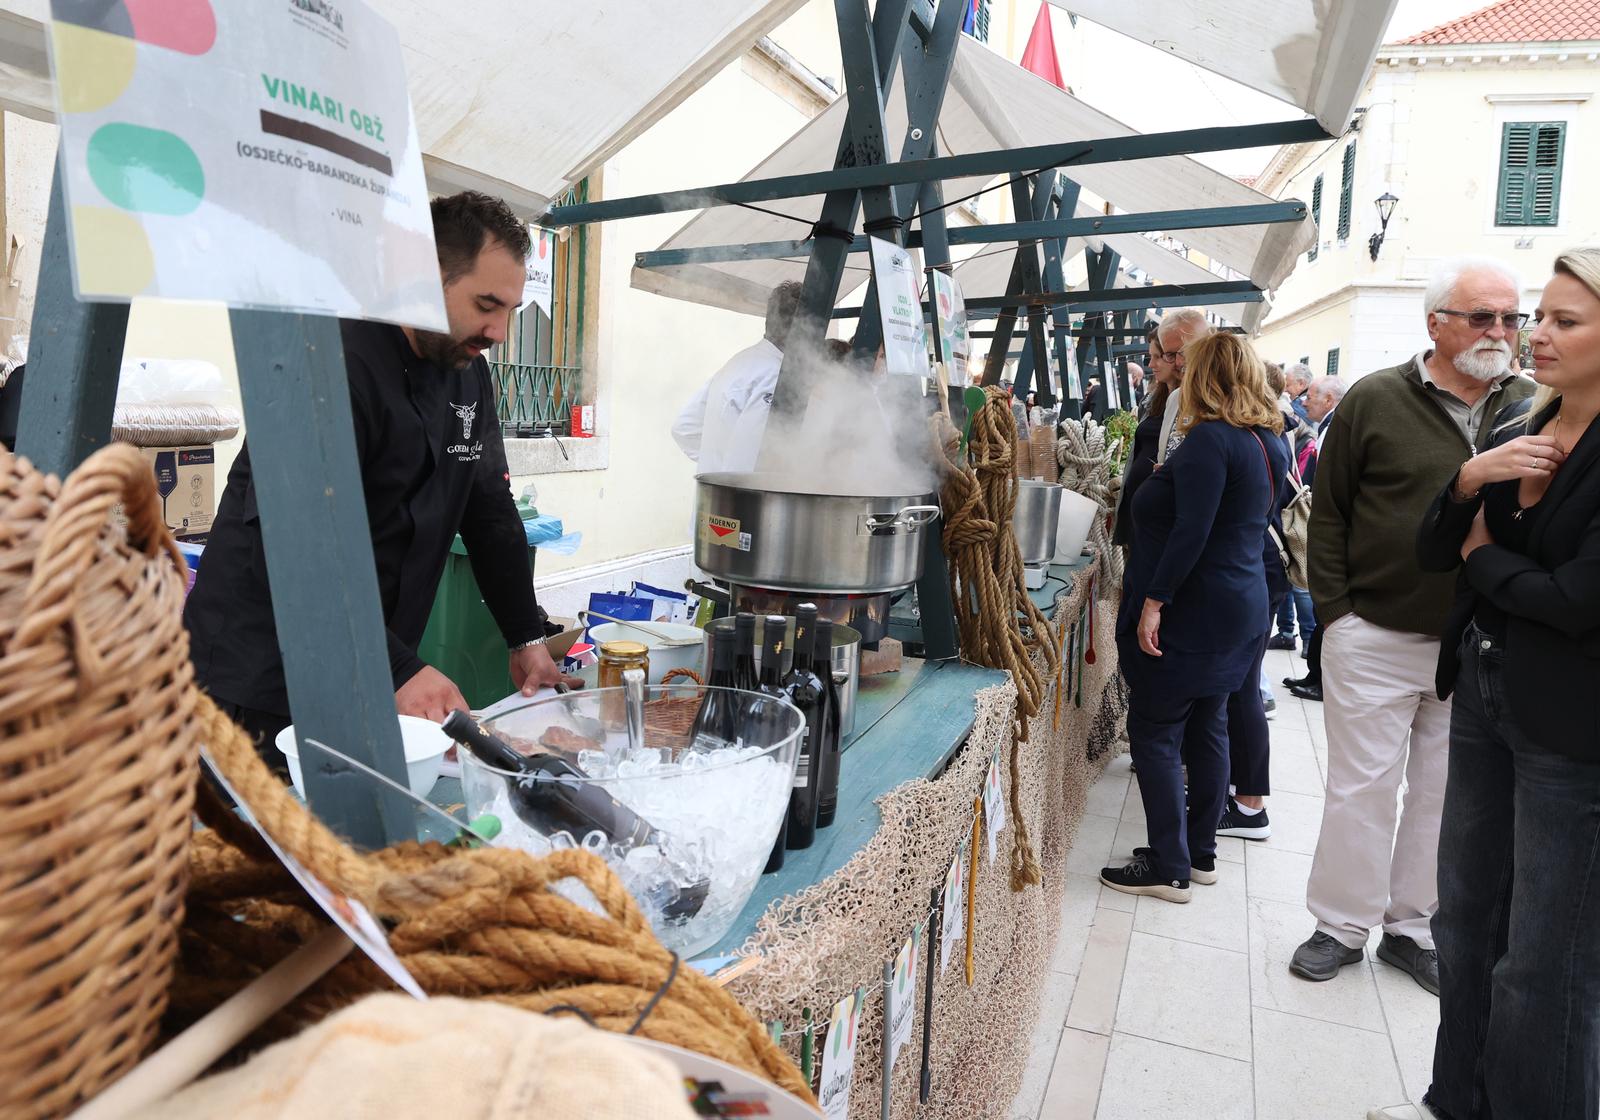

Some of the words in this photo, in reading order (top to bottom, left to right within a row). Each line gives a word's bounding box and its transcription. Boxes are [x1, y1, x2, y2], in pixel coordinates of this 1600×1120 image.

[261, 73, 345, 123] VINARI
[349, 109, 385, 142] OBŽ
[237, 141, 369, 189] (OSJEČKO-BARANJSKA
[336, 207, 363, 226] VINA
[709, 516, 737, 529] PADERNO
